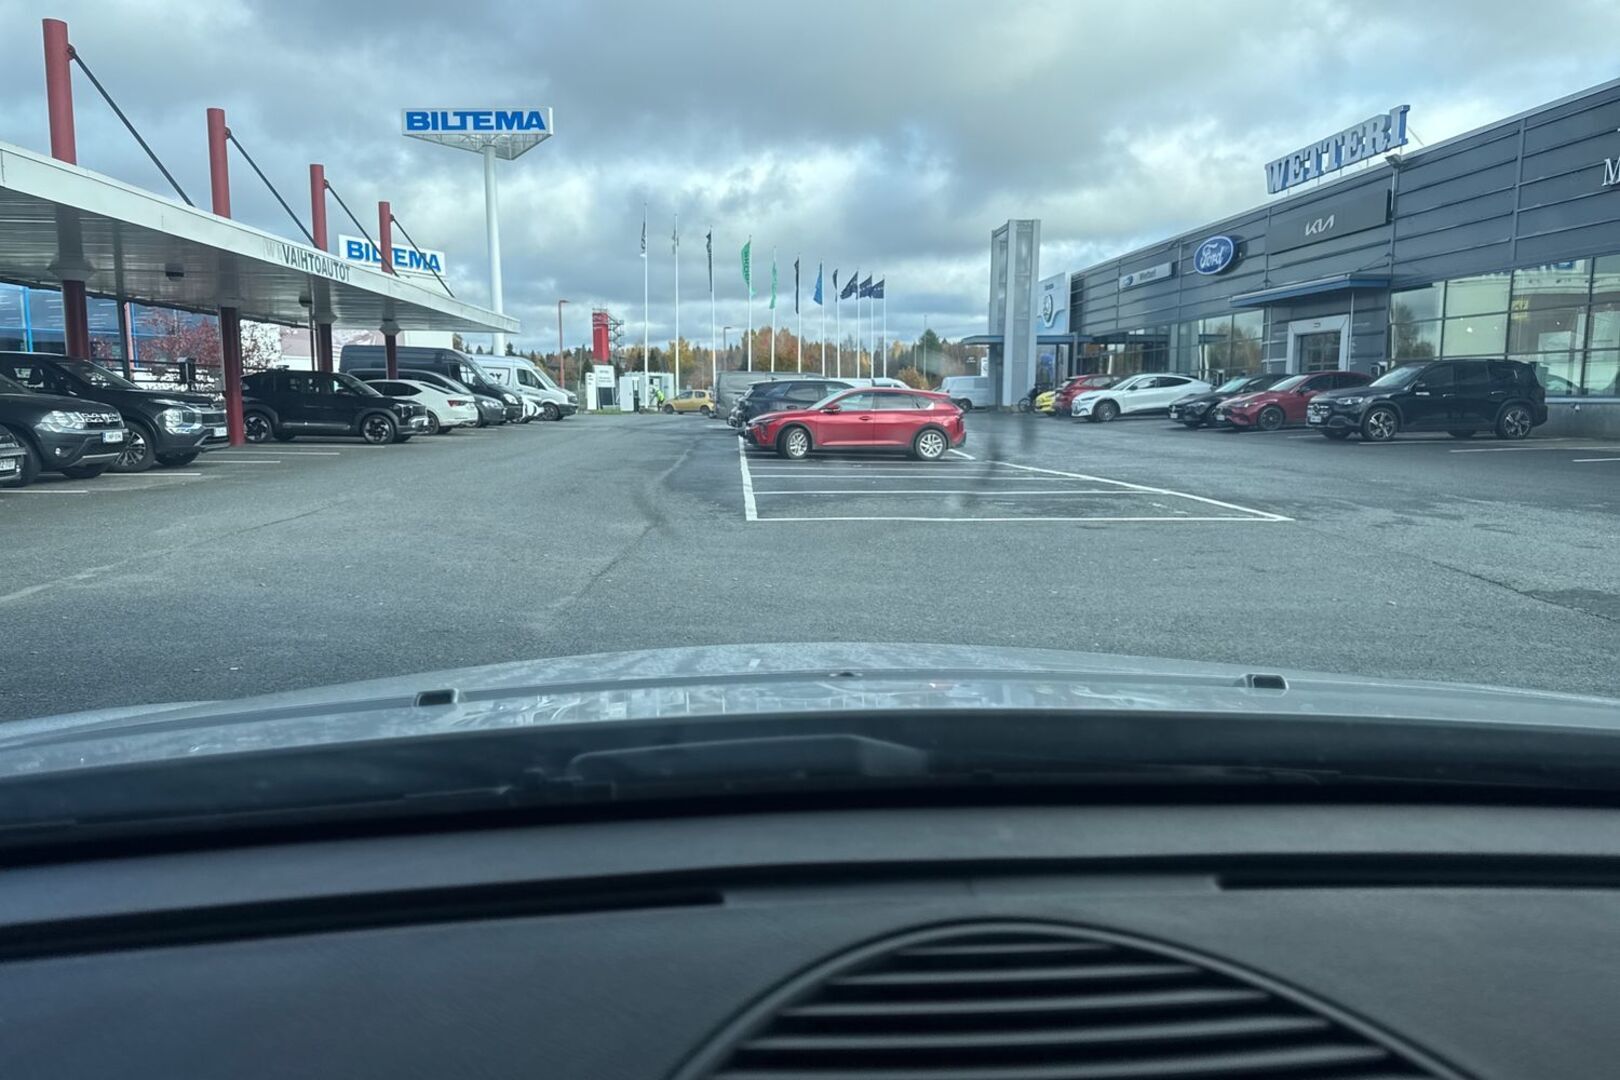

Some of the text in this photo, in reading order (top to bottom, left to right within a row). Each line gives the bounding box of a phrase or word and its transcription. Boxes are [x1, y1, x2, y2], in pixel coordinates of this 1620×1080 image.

[406, 111, 546, 131] BILTEMA
[1265, 105, 1410, 195] WETTERI
[1305, 214, 1335, 236] KIA
[282, 244, 350, 283] VAIHTOAUTOT
[346, 240, 442, 273] BILEMA
[1200, 242, 1226, 270] Ford
